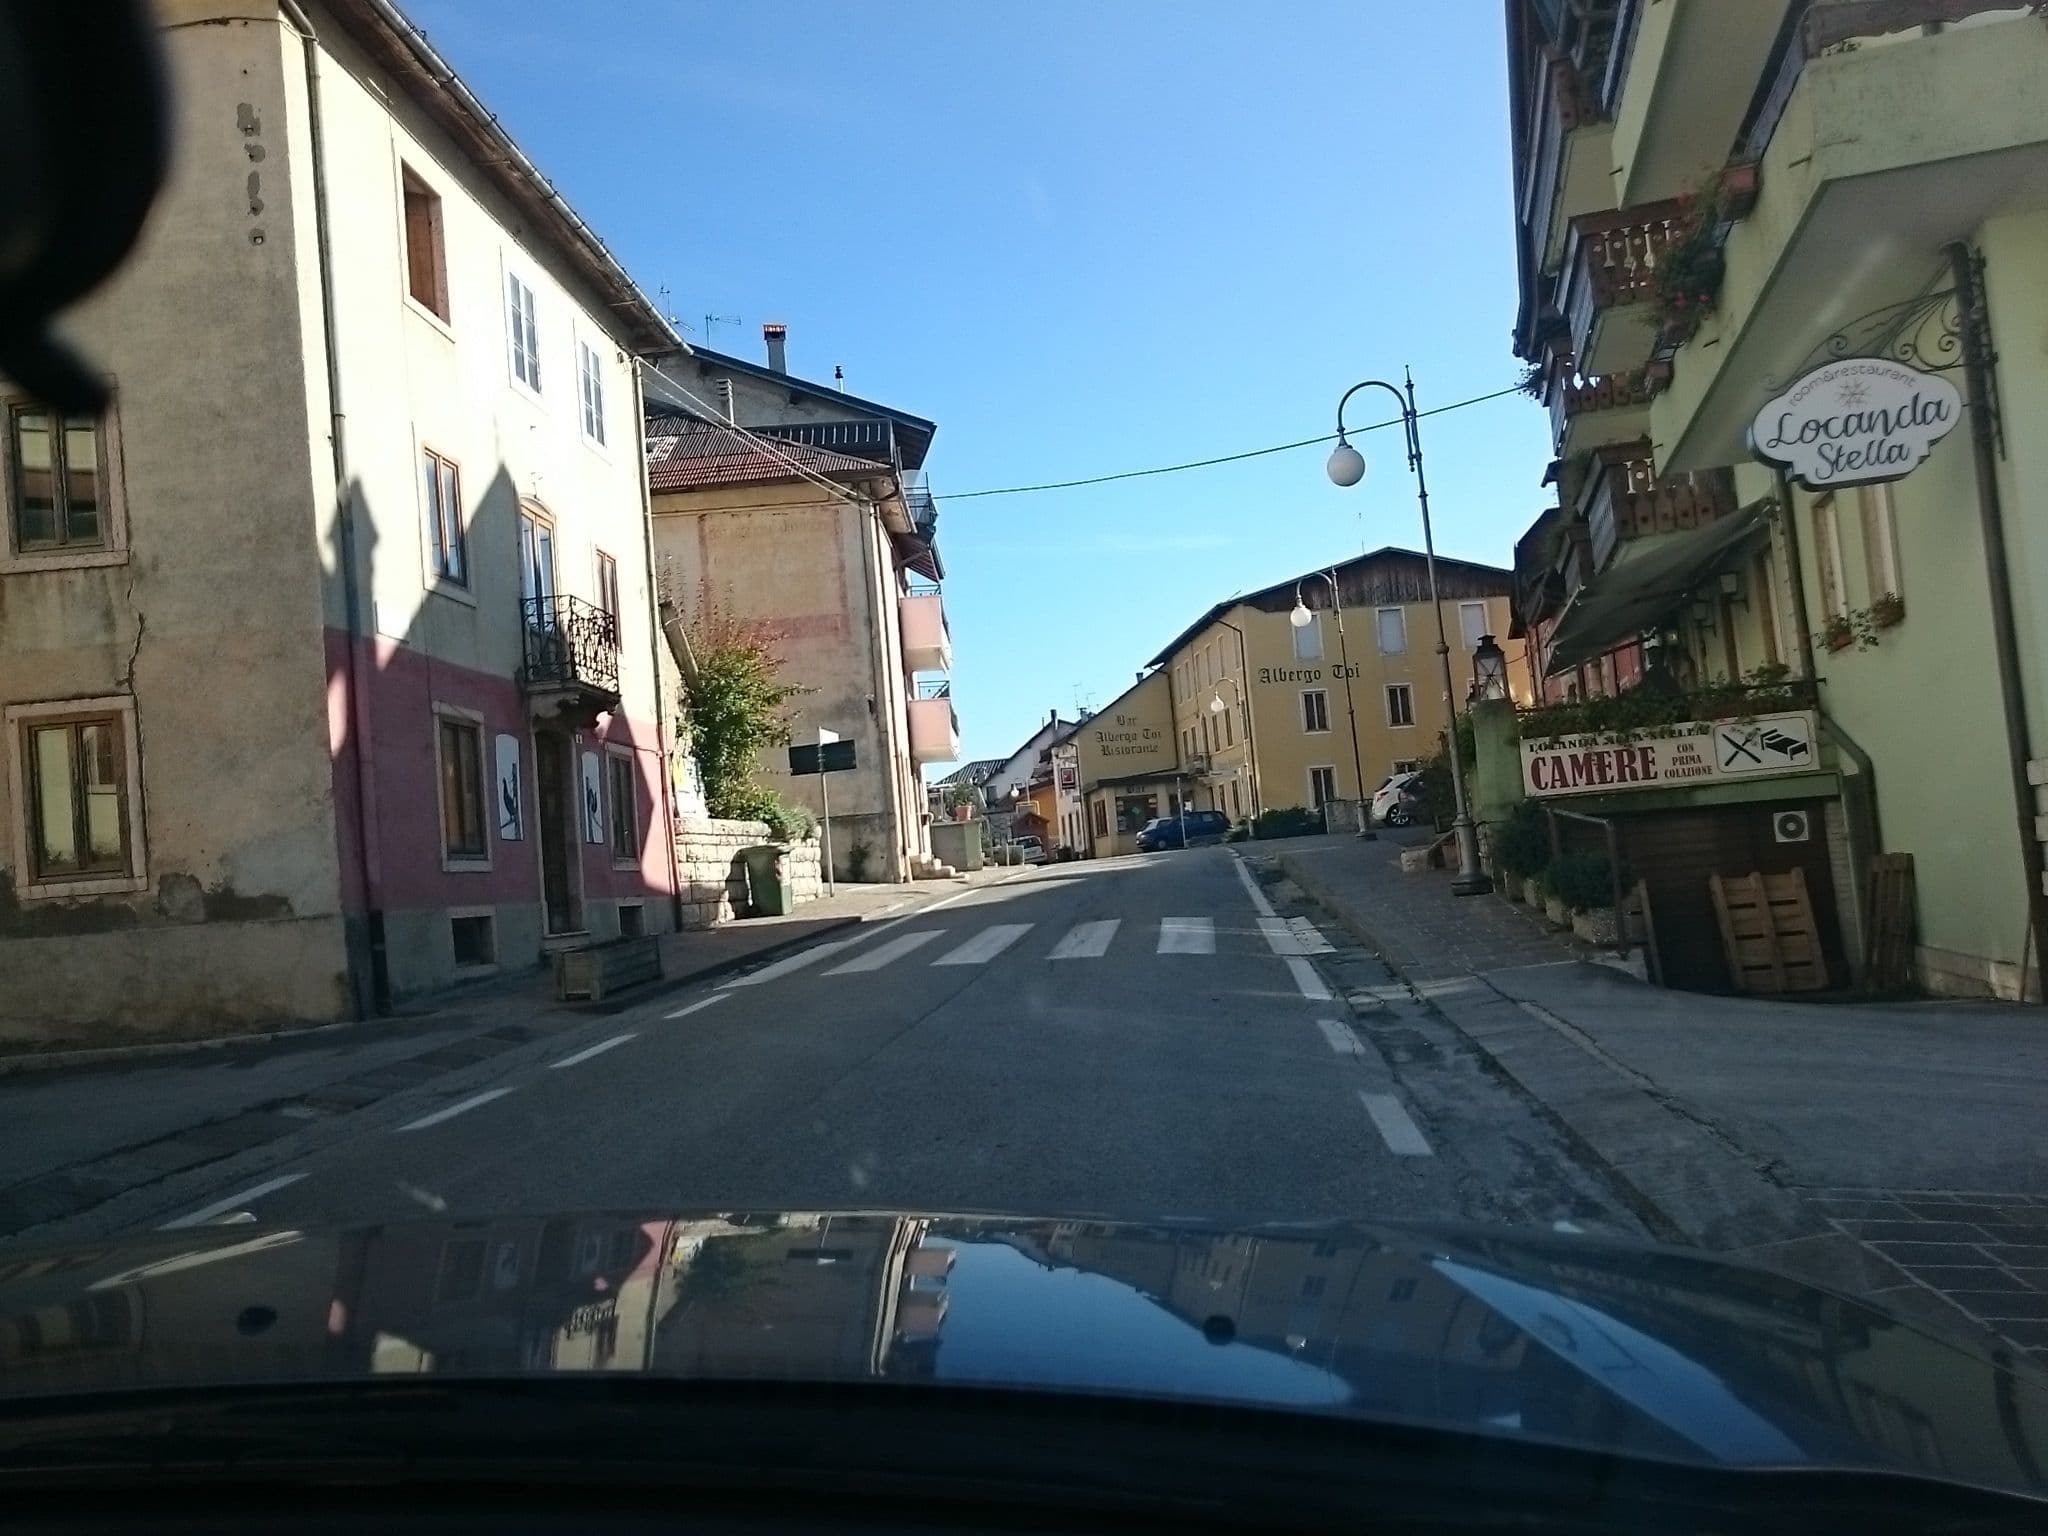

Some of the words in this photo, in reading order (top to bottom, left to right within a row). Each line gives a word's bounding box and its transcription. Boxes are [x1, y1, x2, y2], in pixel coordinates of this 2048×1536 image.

[1767, 391, 1951, 449] Locanda
[1814, 438, 1909, 480] Stella
[1258, 667, 1322, 684] Albergo
[1331, 662, 1361, 680] Toi
[1096, 730, 1137, 743] Albergo
[1100, 744, 1159, 756] Ristorante
[1677, 742, 1694, 753] CON
[1672, 754, 1702, 766] PRIMA
[1530, 745, 1658, 791] CAMERE
[1664, 765, 1713, 779] COLAZIONE
